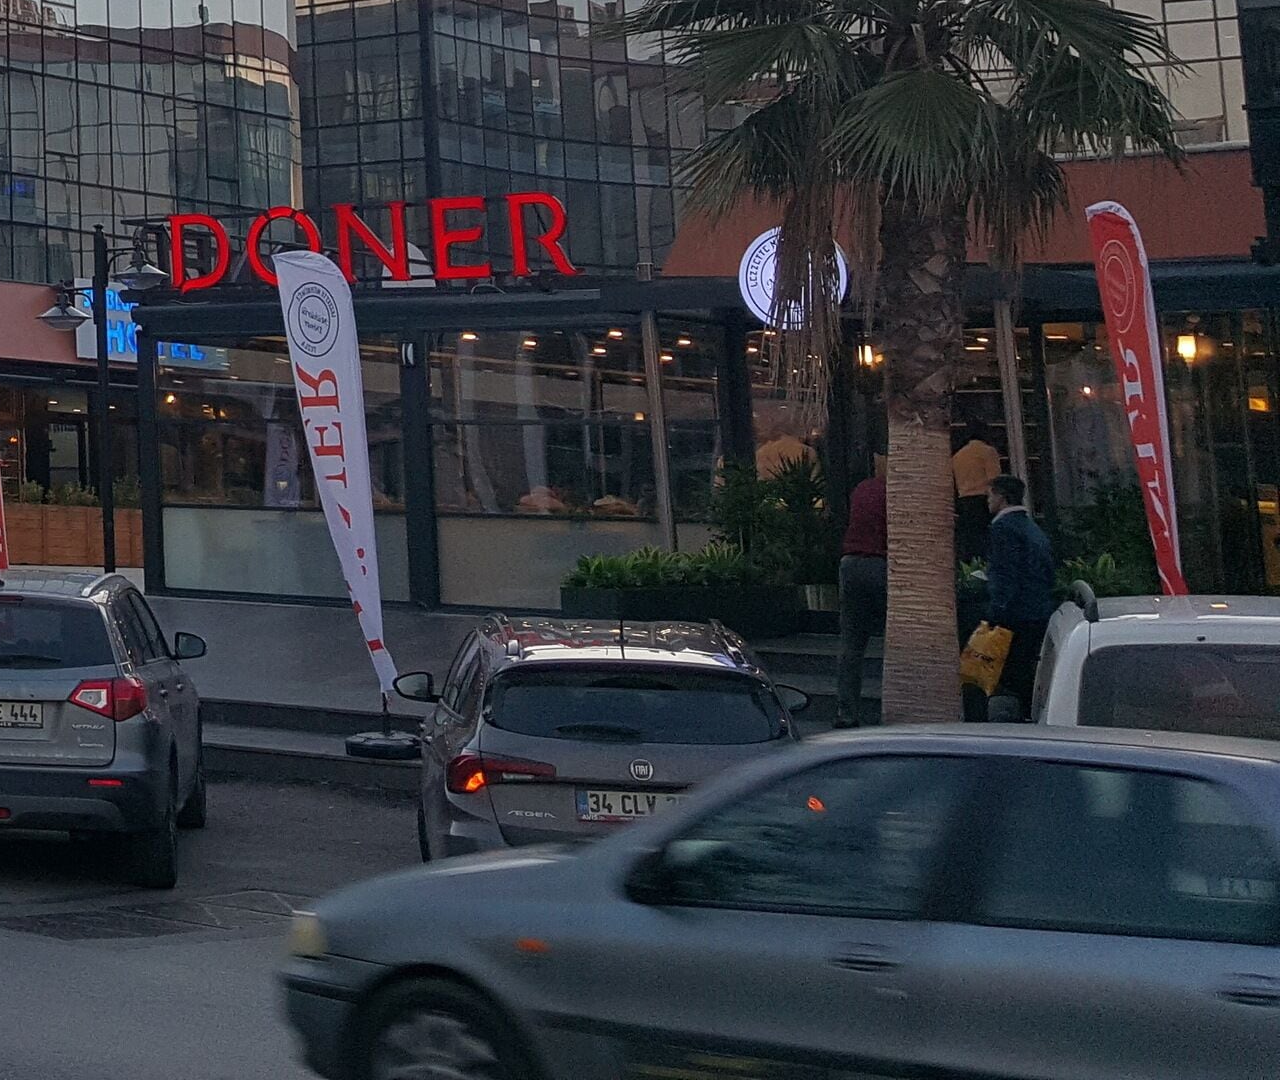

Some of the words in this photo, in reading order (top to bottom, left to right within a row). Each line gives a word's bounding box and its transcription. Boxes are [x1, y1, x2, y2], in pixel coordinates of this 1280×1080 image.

[9, 704, 38, 721] 444
[590, 793, 613, 813] 34
[621, 794, 657, 815] CLV
